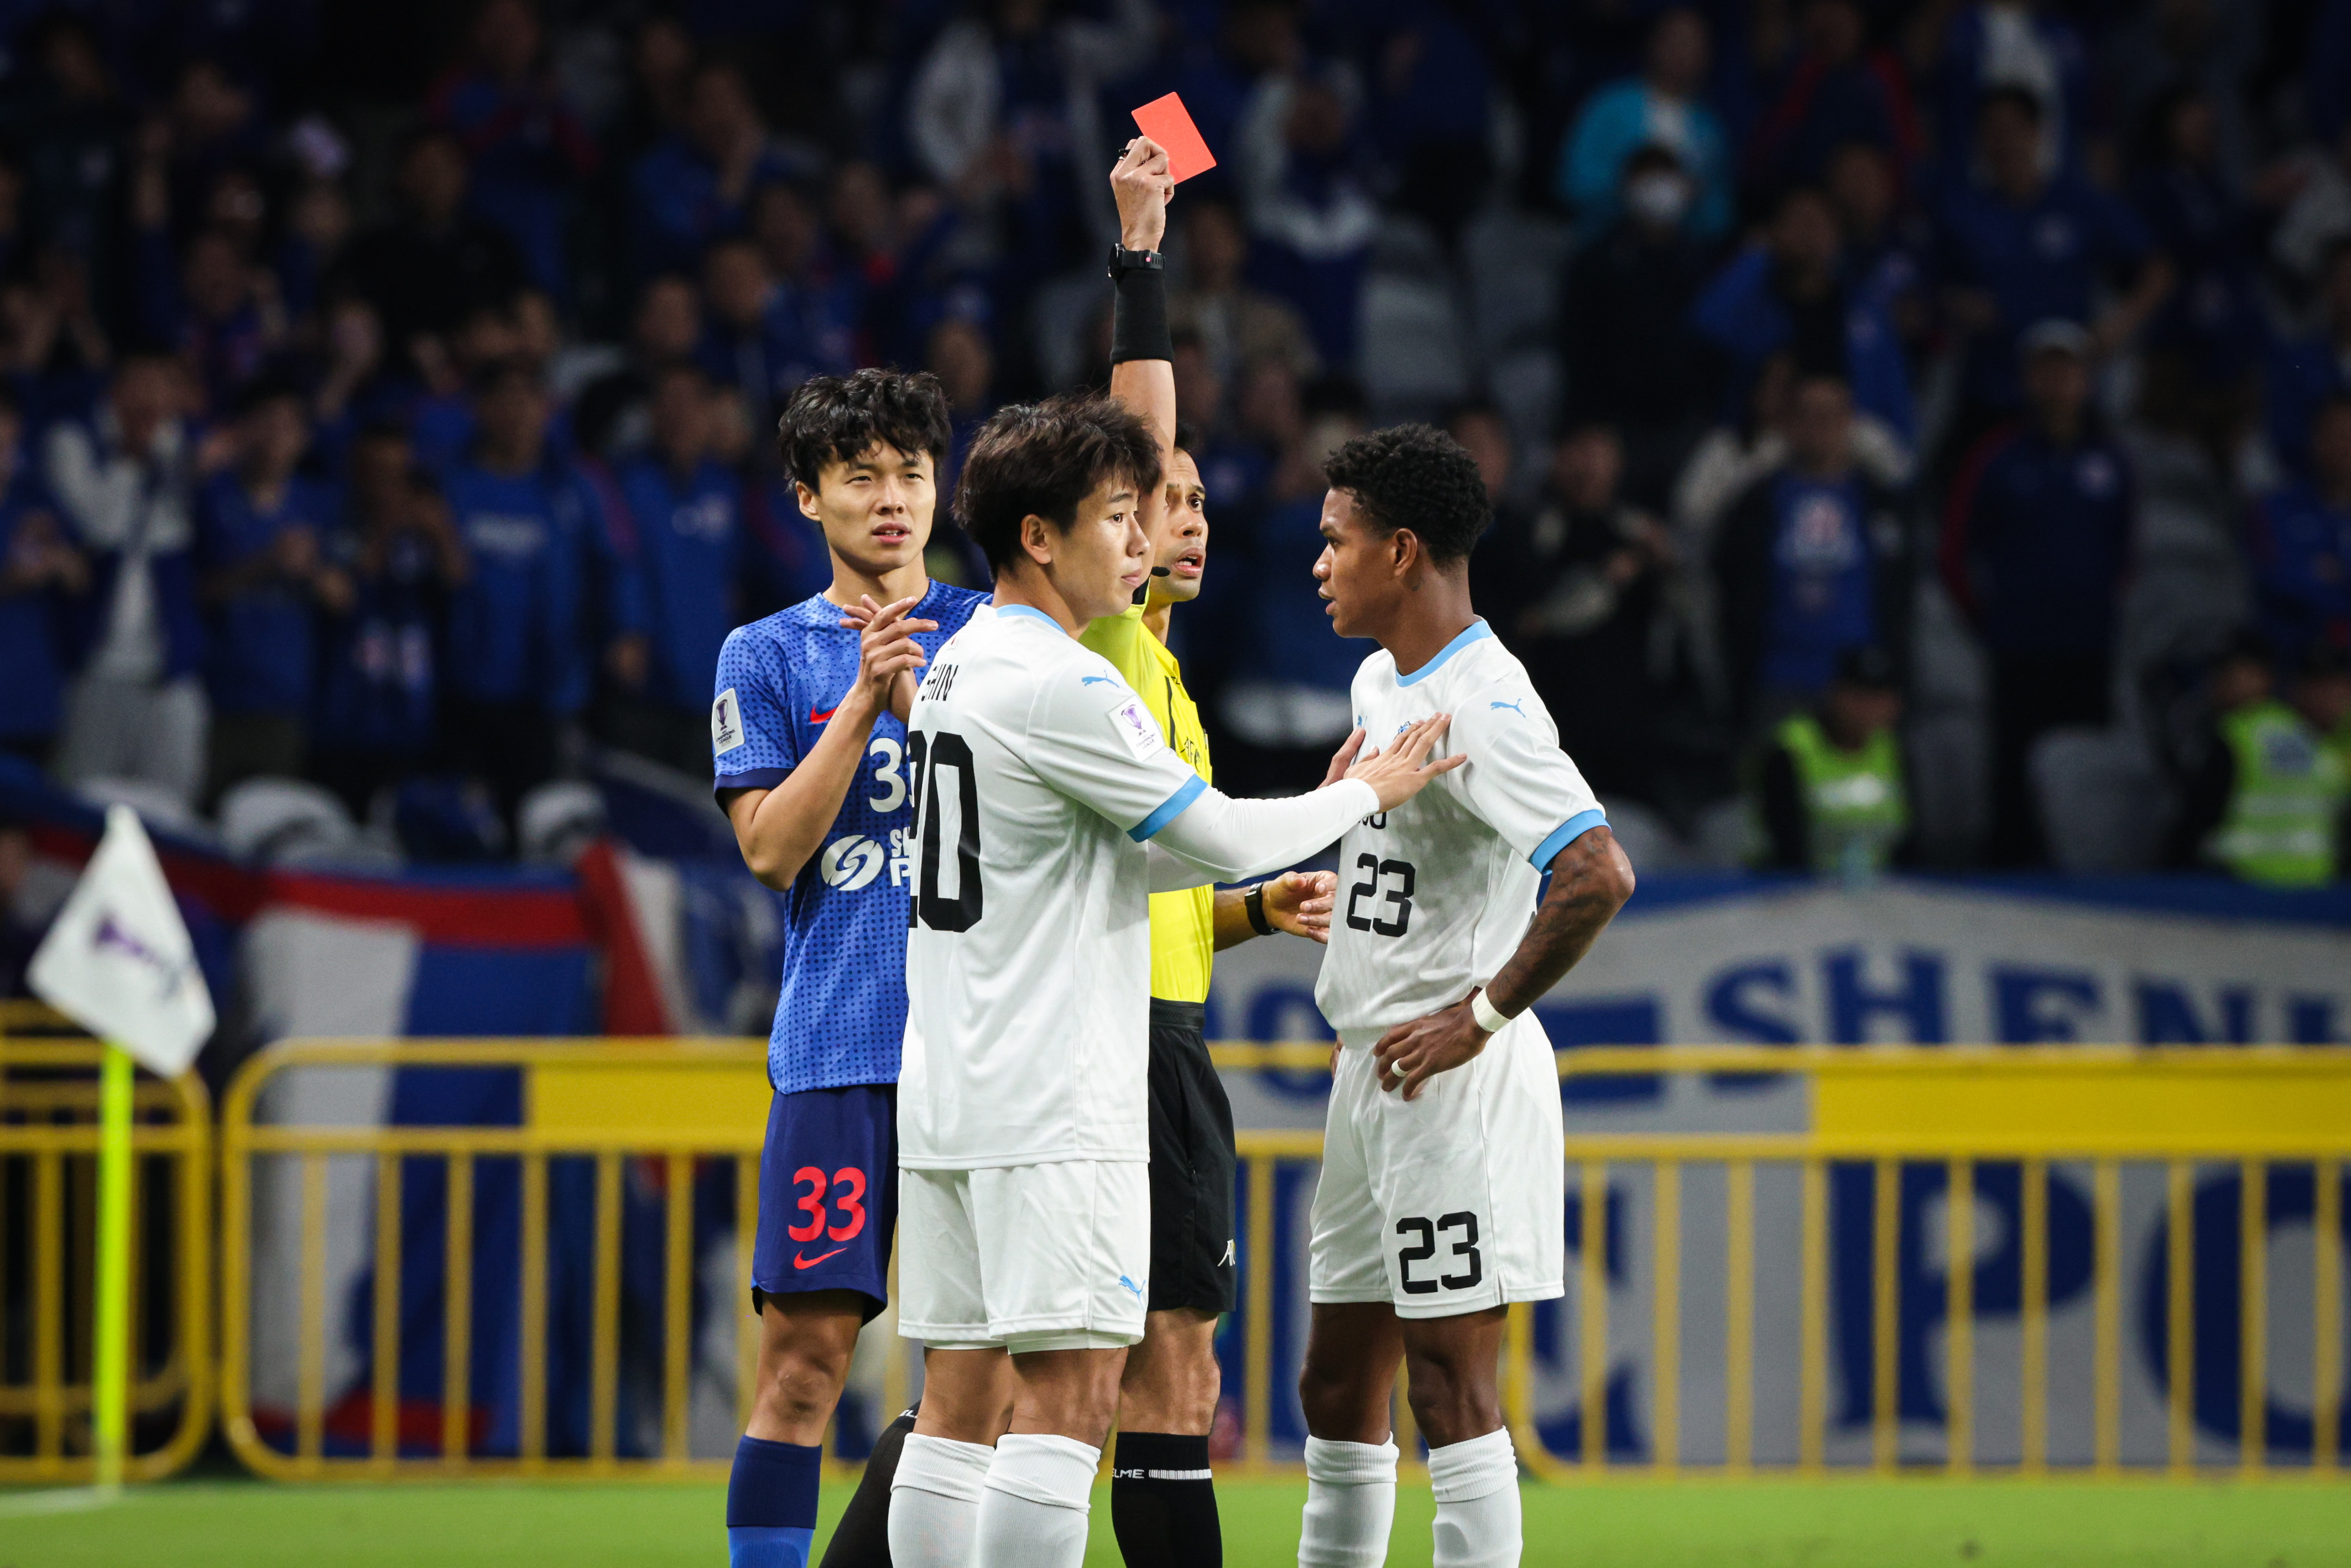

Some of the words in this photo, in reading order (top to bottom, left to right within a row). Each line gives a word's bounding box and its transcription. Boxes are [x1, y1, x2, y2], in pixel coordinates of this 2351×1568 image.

[869, 737, 913, 812] 3
[1346, 852, 1416, 937] 23
[788, 1166, 867, 1242] 33
[1396, 1211, 1482, 1294] 23
